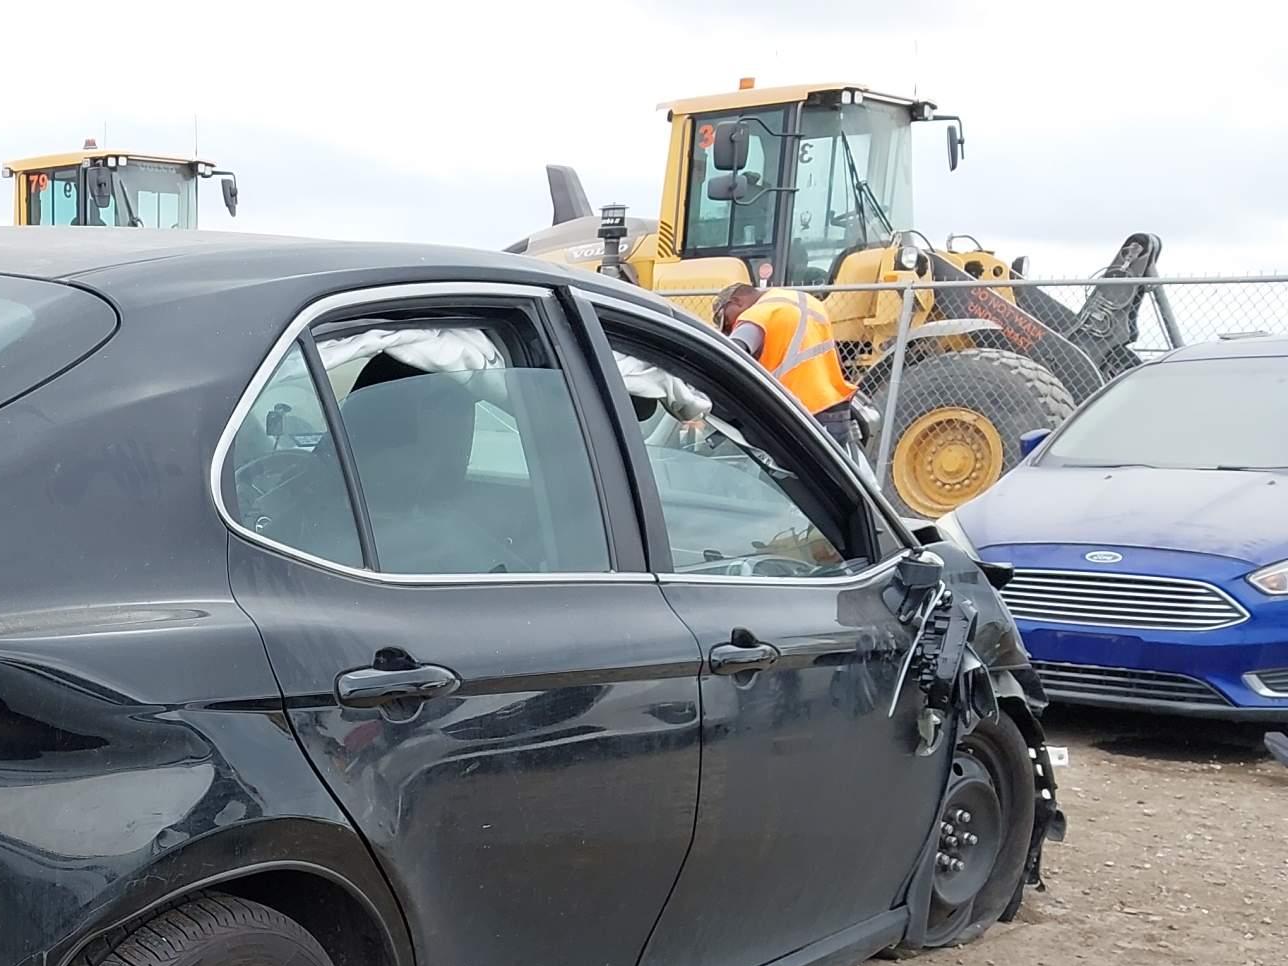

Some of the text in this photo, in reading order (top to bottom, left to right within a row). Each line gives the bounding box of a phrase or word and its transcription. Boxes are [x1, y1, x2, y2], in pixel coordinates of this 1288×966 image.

[29, 174, 48, 193] 79
[572, 243, 629, 258] VOLO
[988, 298, 1015, 318] NOT
[1015, 314, 1046, 340] WALK
